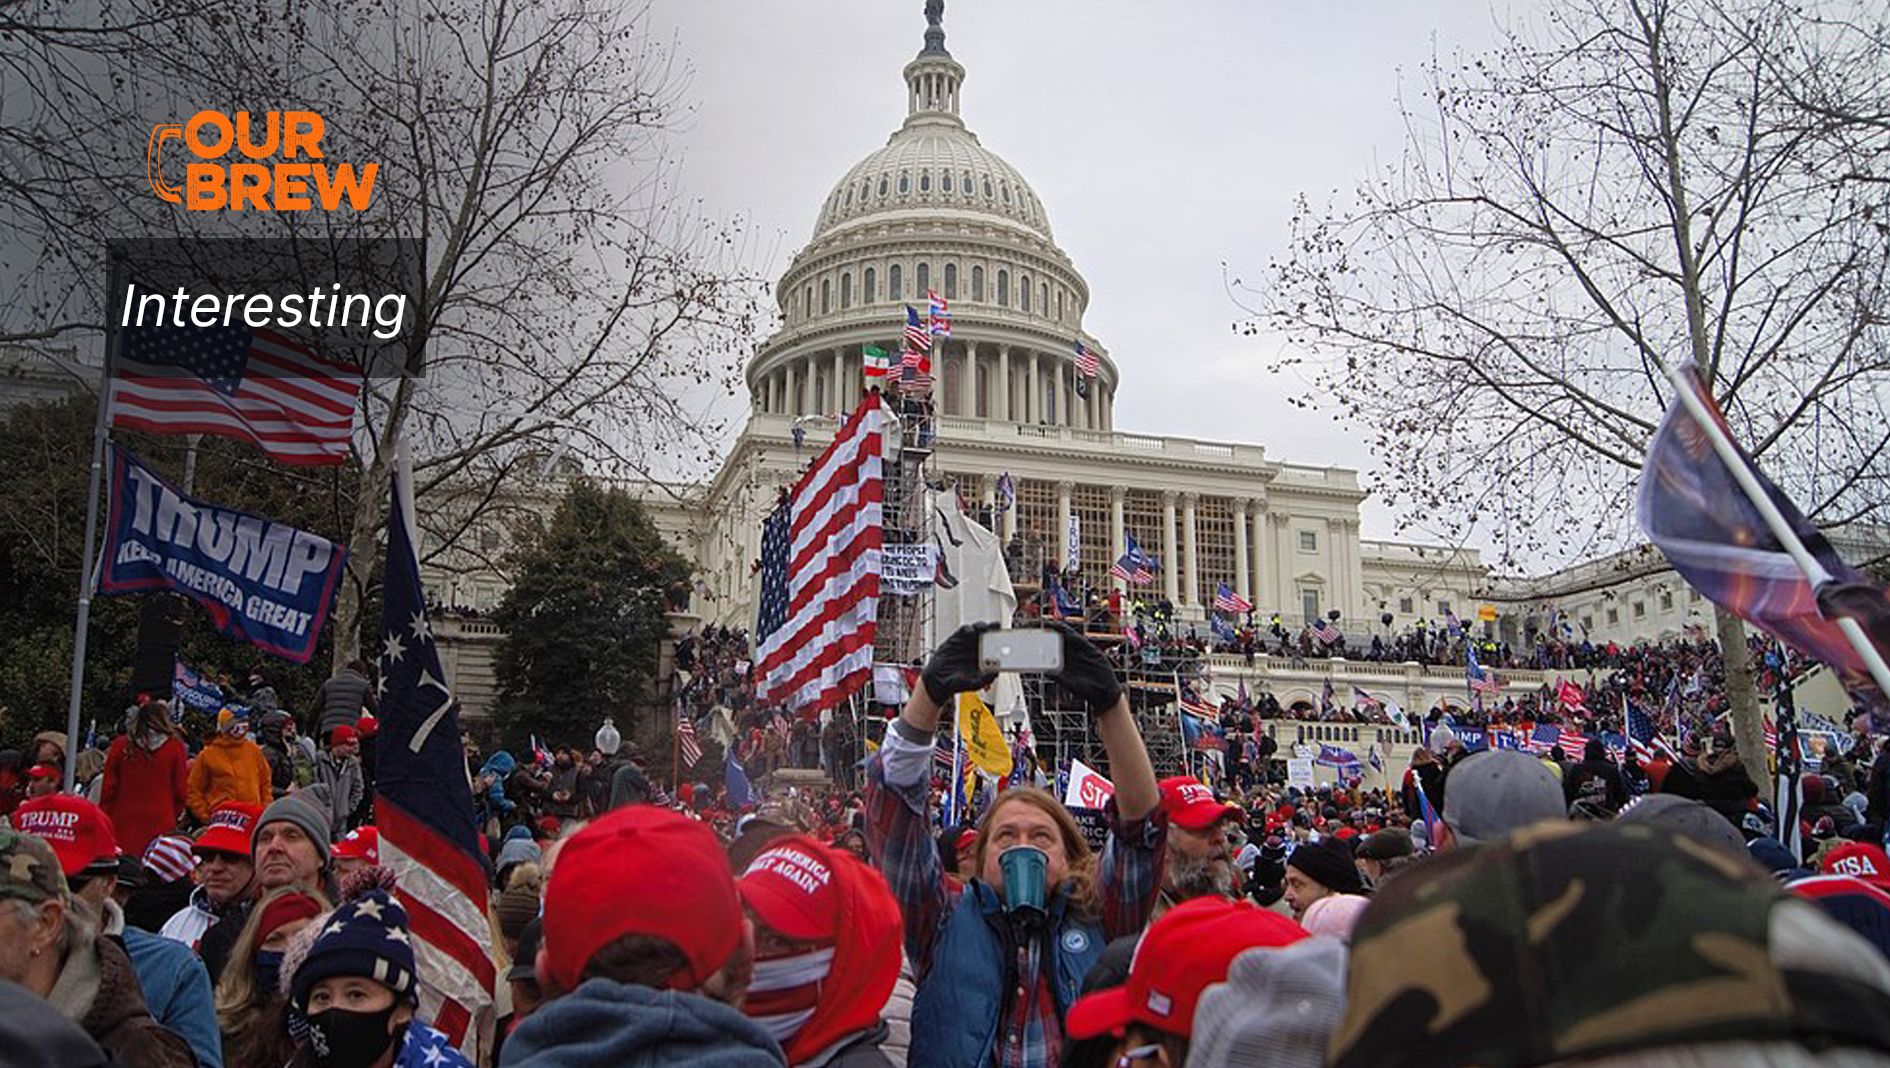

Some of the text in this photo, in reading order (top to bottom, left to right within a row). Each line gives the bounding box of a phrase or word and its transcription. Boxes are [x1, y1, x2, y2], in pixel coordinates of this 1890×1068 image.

[129, 465, 332, 595] TRUMP
[117, 540, 312, 636] KEEP AMERICA GREAT
[21, 810, 80, 828] TRUMP
[773, 860, 820, 894] AGAIN
[774, 847, 832, 885] AMERICA
[1832, 854, 1878, 876] USA
